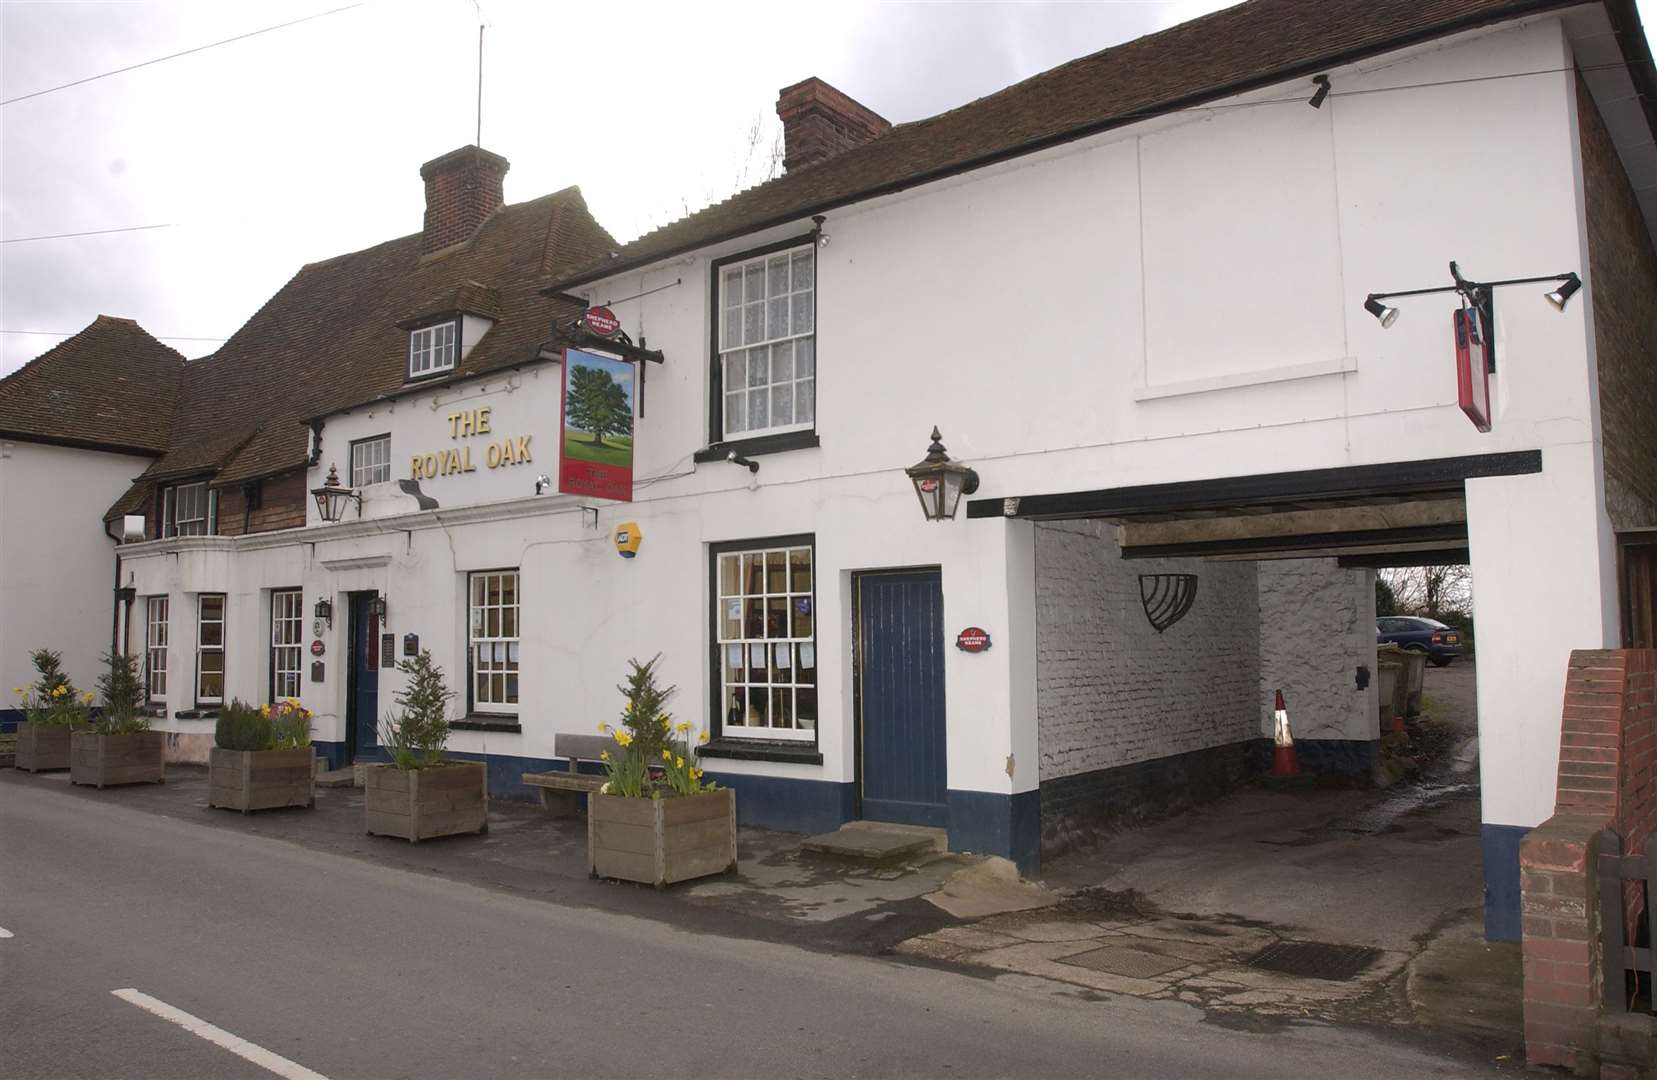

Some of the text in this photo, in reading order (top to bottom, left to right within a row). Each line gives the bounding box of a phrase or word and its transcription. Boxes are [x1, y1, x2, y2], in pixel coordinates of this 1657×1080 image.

[448, 405, 492, 440] THE
[410, 435, 532, 481] ROYAL OAK
